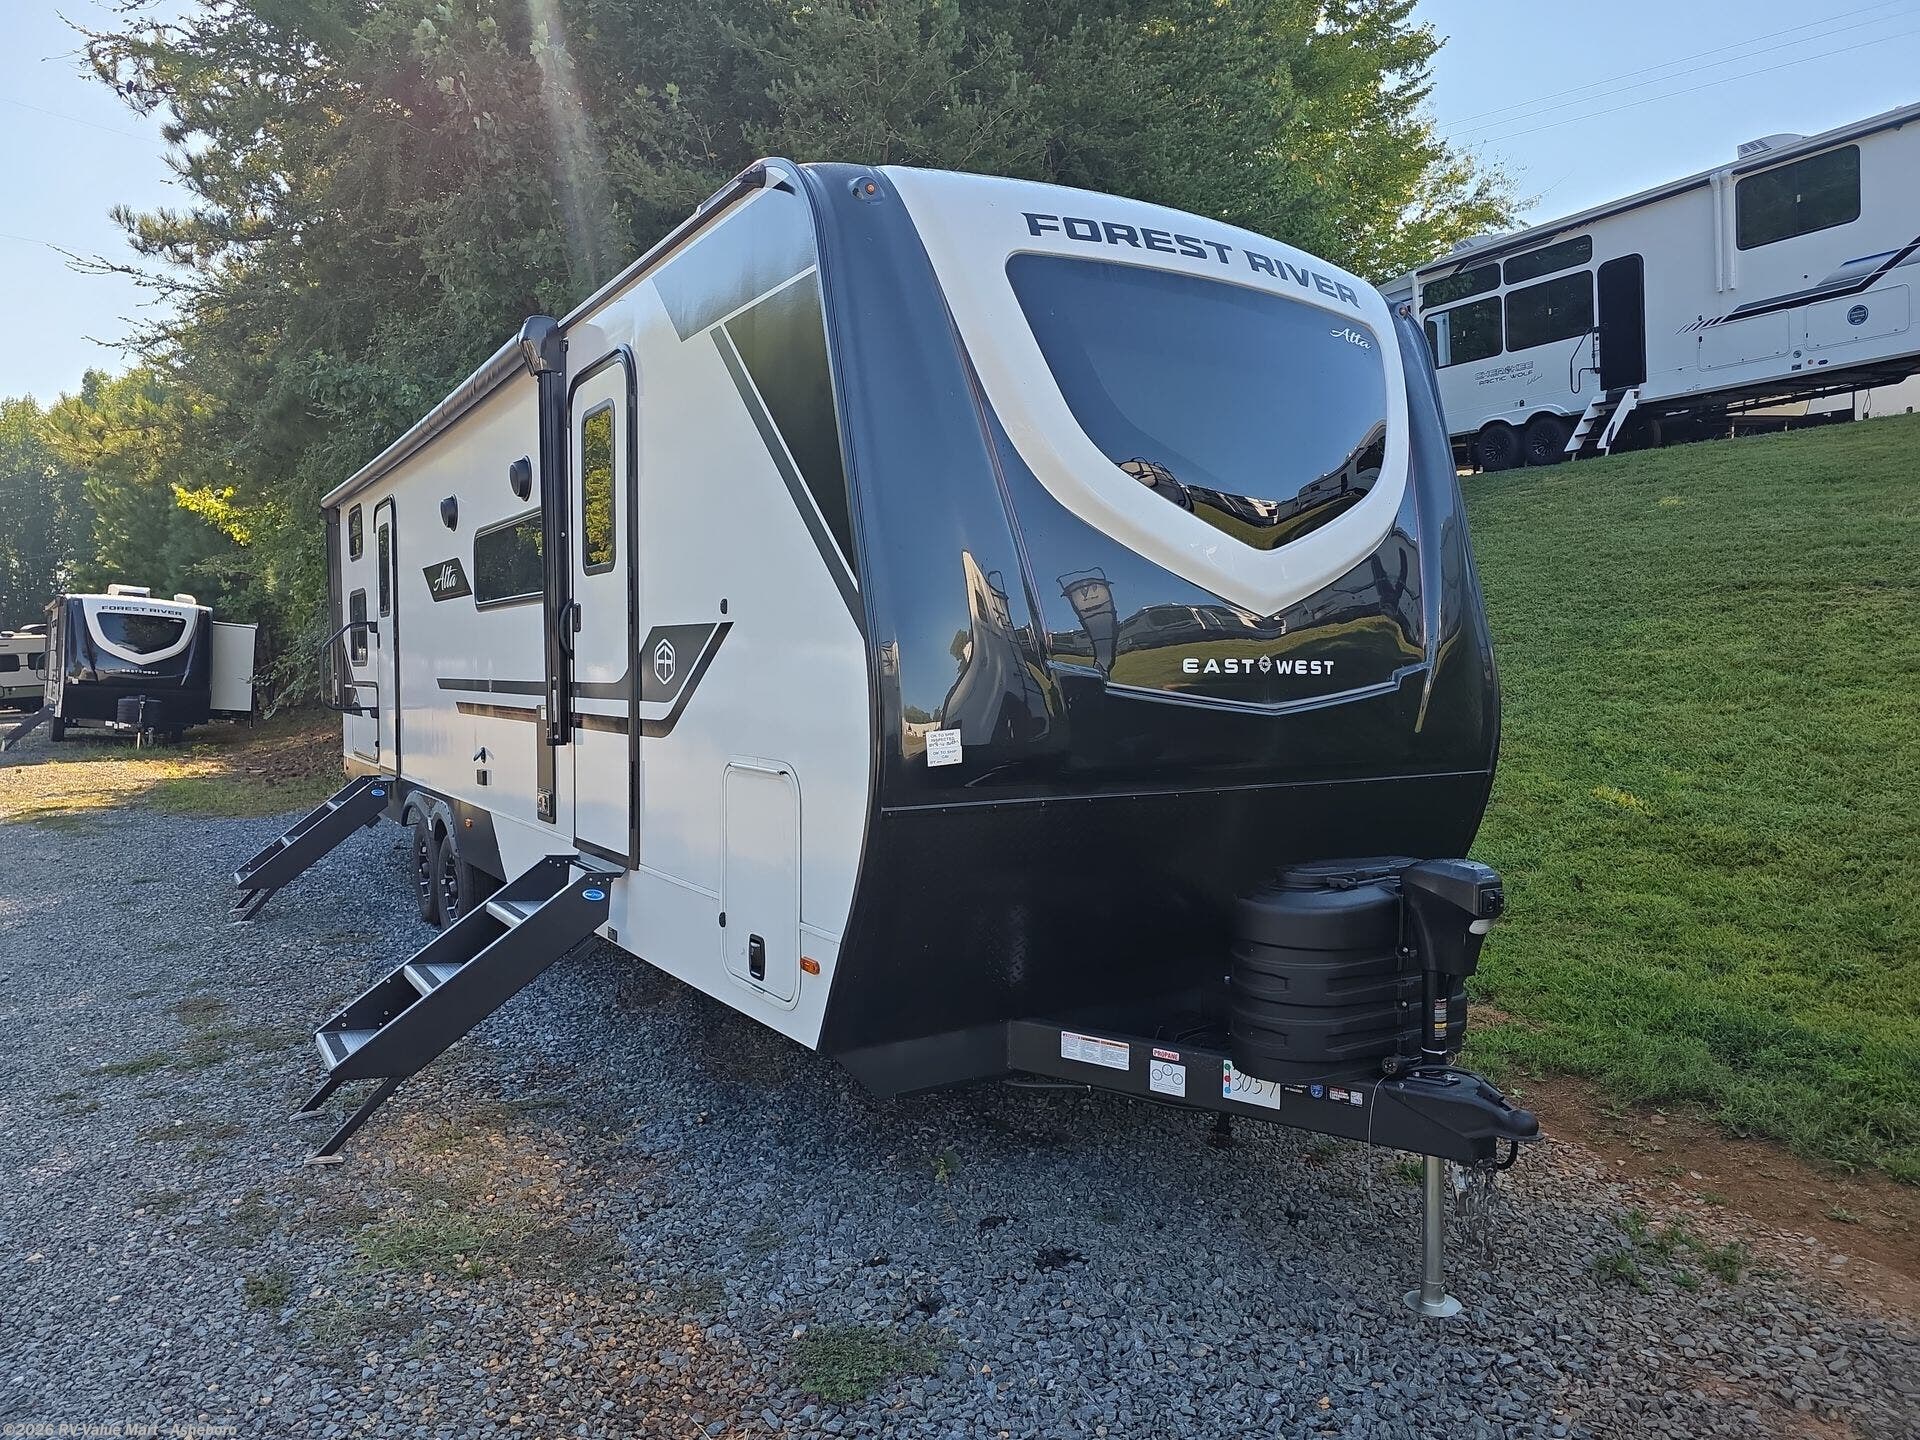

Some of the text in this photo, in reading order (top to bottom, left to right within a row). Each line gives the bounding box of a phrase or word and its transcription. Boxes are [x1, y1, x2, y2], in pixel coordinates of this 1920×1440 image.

[1020, 212, 1362, 310] FOREST RIVER
[1329, 327, 1371, 350] Alta
[1478, 375, 1507, 386] ARCTIC
[1510, 369, 1534, 379] WOLF
[433, 564, 458, 592] Alta
[149, 608, 182, 616] RIVER
[1182, 658, 1255, 674] EAST
[1276, 659, 1335, 675] WEST
[1154, 1049, 1178, 1060] PROPANE
